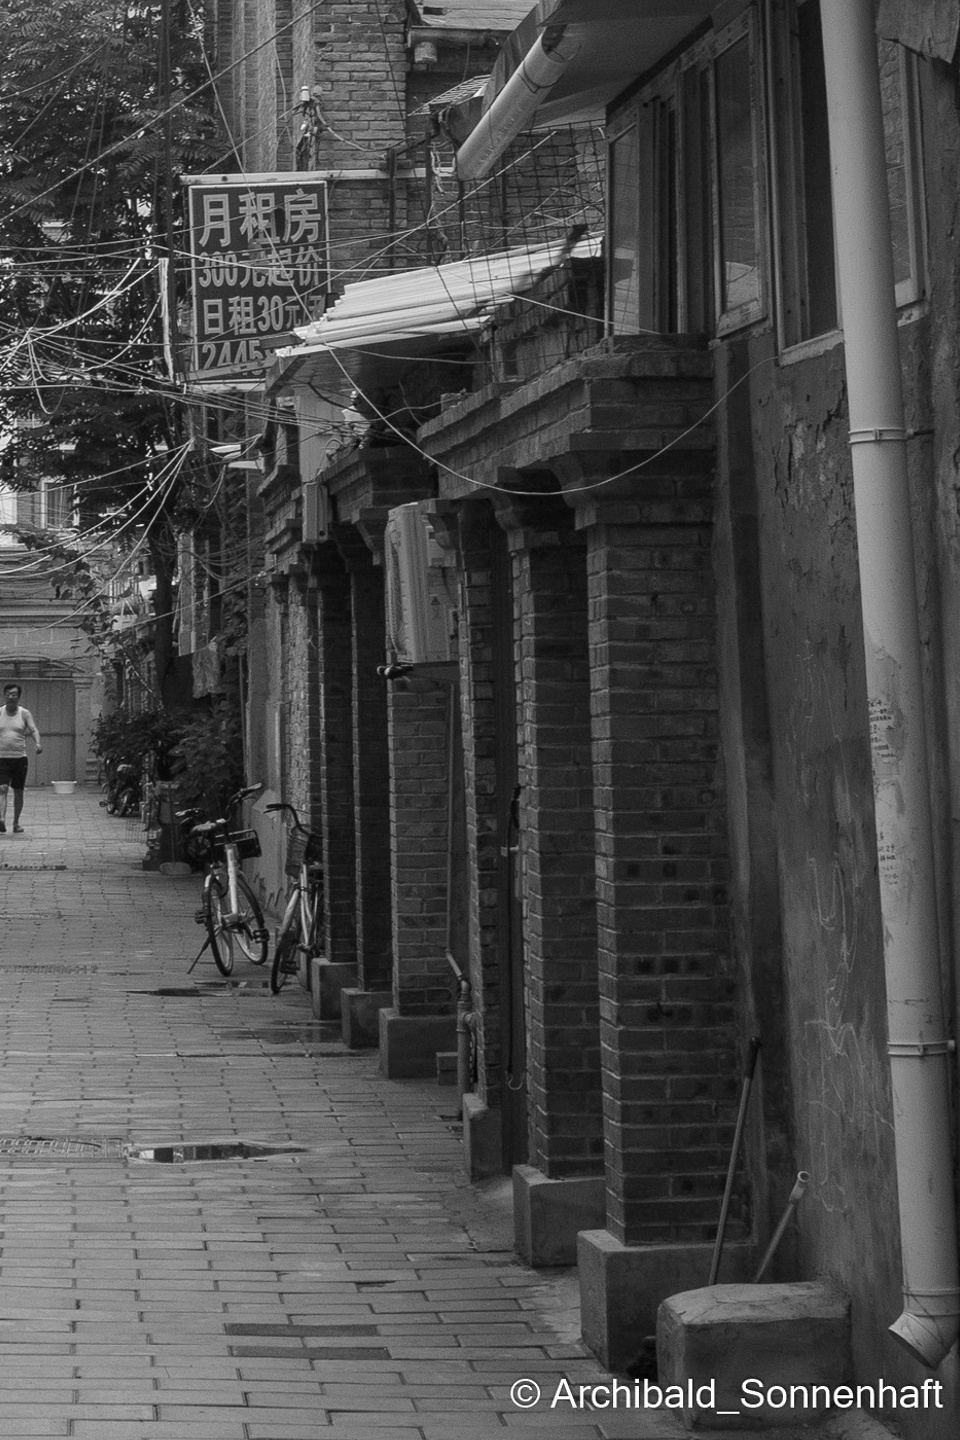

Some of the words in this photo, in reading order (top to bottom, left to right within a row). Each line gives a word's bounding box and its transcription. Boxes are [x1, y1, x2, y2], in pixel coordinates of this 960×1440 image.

[198, 188, 322, 247] 月租房
[198, 245, 323, 288] 300元起价
